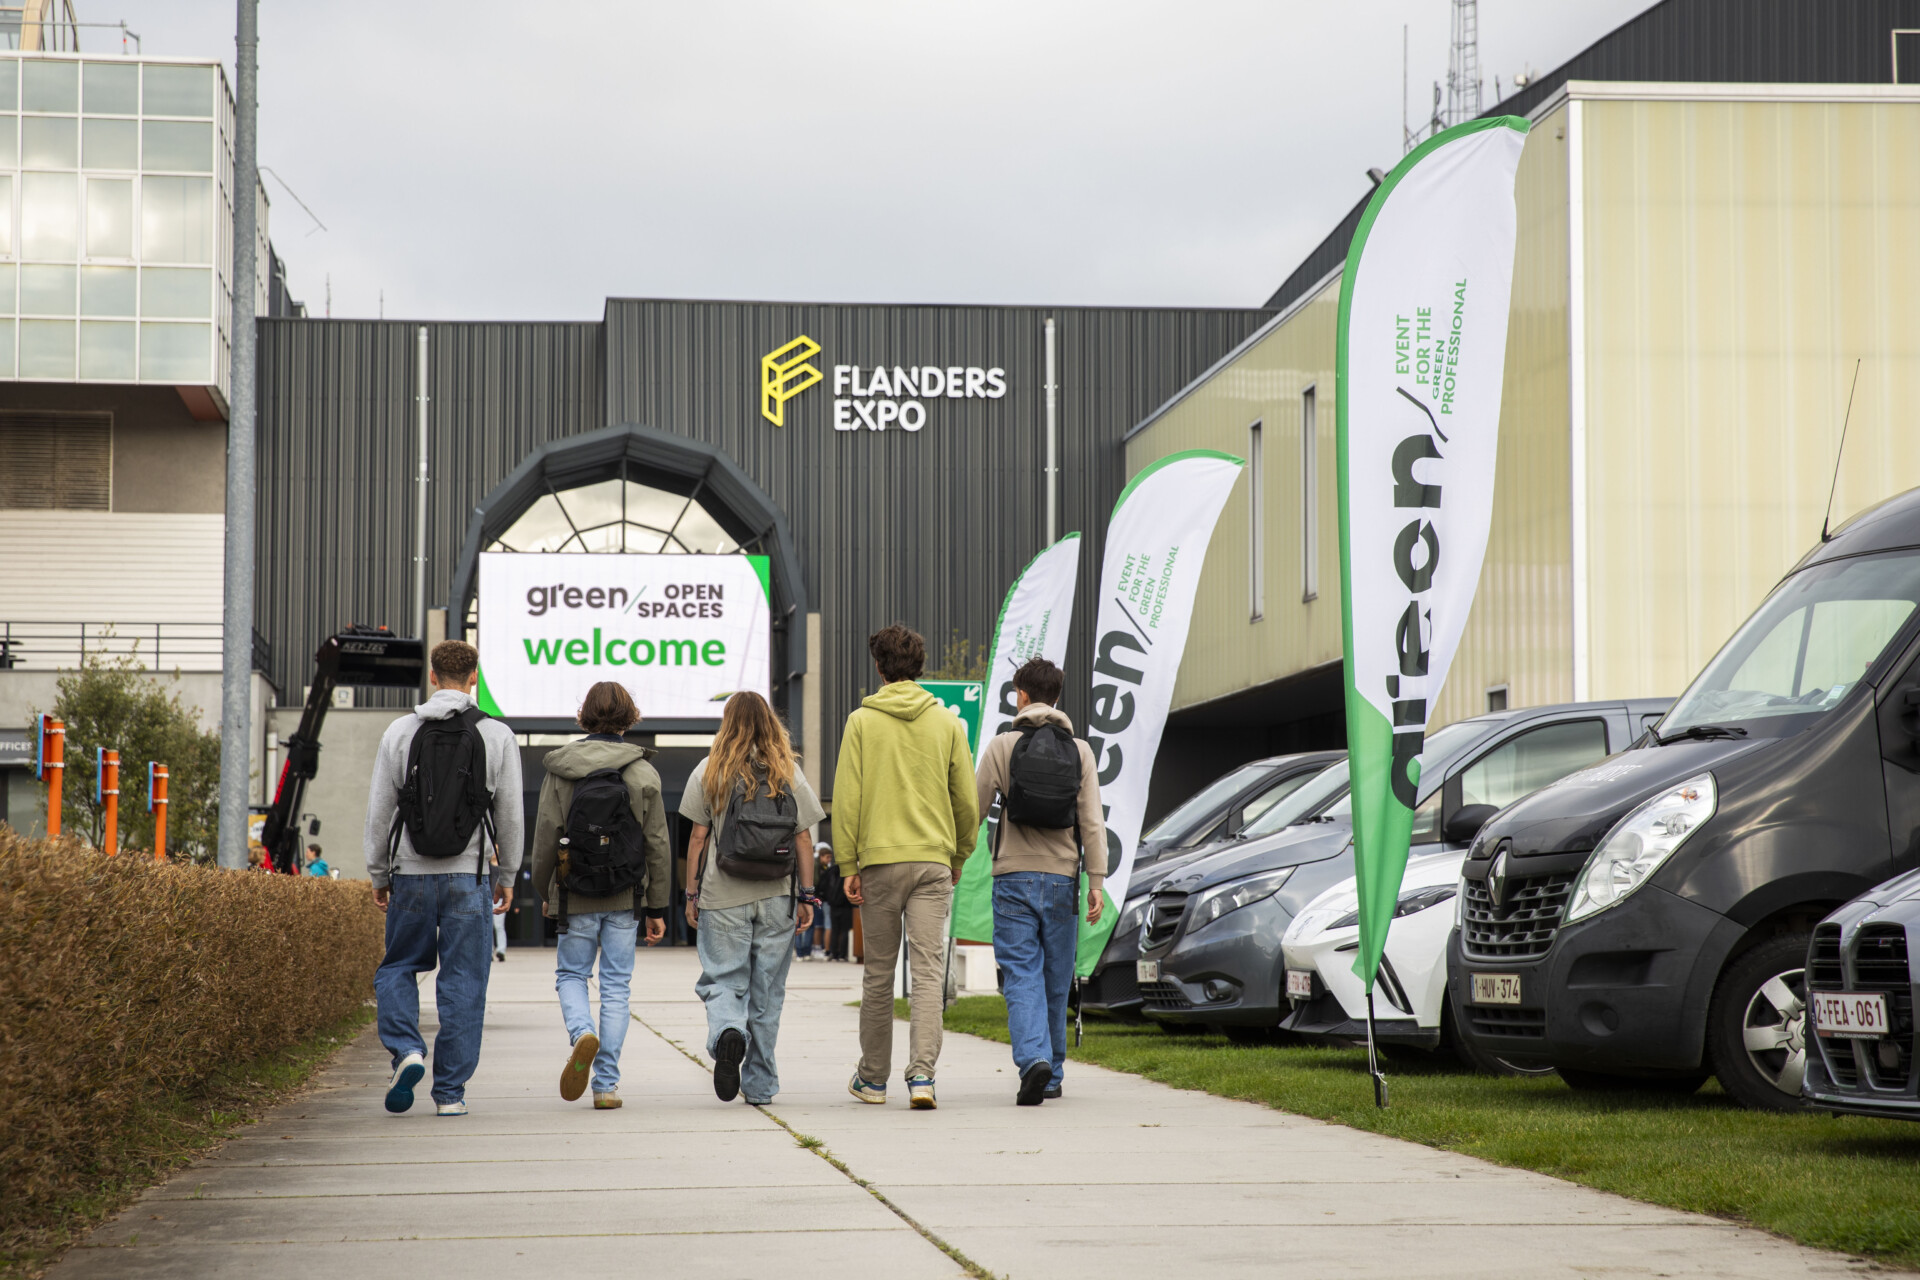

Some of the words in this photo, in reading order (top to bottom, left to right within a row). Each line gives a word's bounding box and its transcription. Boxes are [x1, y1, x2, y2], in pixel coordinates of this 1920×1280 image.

[1417, 307, 1431, 343] THE
[1396, 314, 1410, 374] EVENT
[1440, 278, 1467, 415] PROFESSIONAL
[834, 365, 1007, 398] FLANDERS
[1416, 347, 1430, 384] FOR
[1432, 340, 1445, 400] GREEN
[834, 399, 926, 431] EXPO
[1118, 554, 1136, 592] EVENT
[1128, 578, 1143, 603] FOR
[1136, 553, 1151, 575] THE
[1149, 546, 1179, 628] PROFESSIONAL
[638, 602, 723, 618] SPACES
[664, 584, 723, 600] OPEN
[1139, 577, 1156, 615] GREEN
[523, 628, 726, 666] welcome
[1024, 637, 1036, 661] REEN
[1035, 609, 1051, 656] ESSIONAL
[1475, 978, 1518, 999] 1-HUV-374
[1816, 999, 1882, 1026] 2-FEA-061
